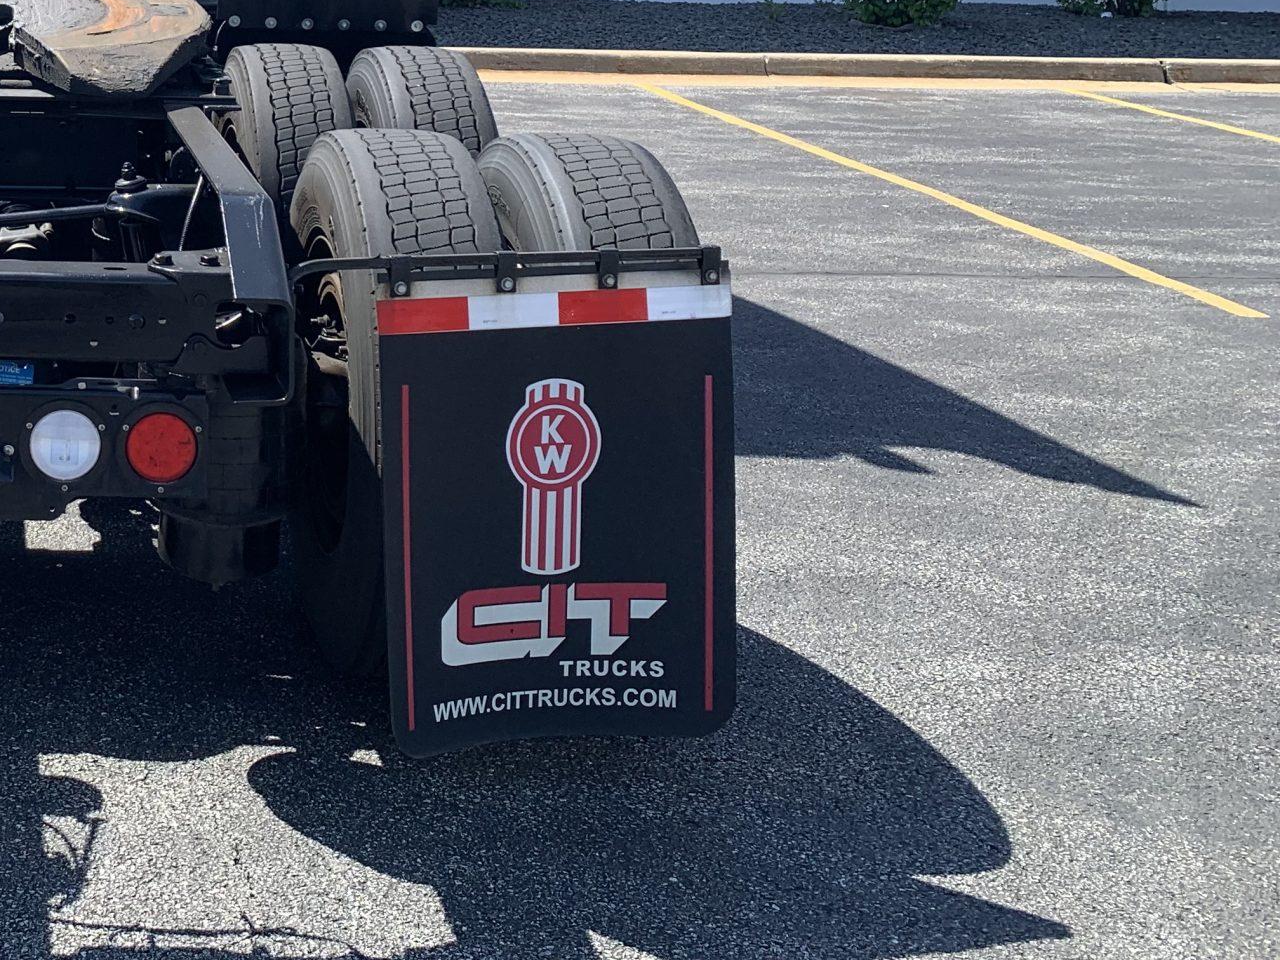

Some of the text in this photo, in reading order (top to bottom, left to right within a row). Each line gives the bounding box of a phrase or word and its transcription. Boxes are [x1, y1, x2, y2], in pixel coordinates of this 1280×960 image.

[441, 583, 667, 666] CIT
[560, 660, 664, 677] TRUCKS
[434, 688, 677, 722] WWW.CITTRUCKS.COM
